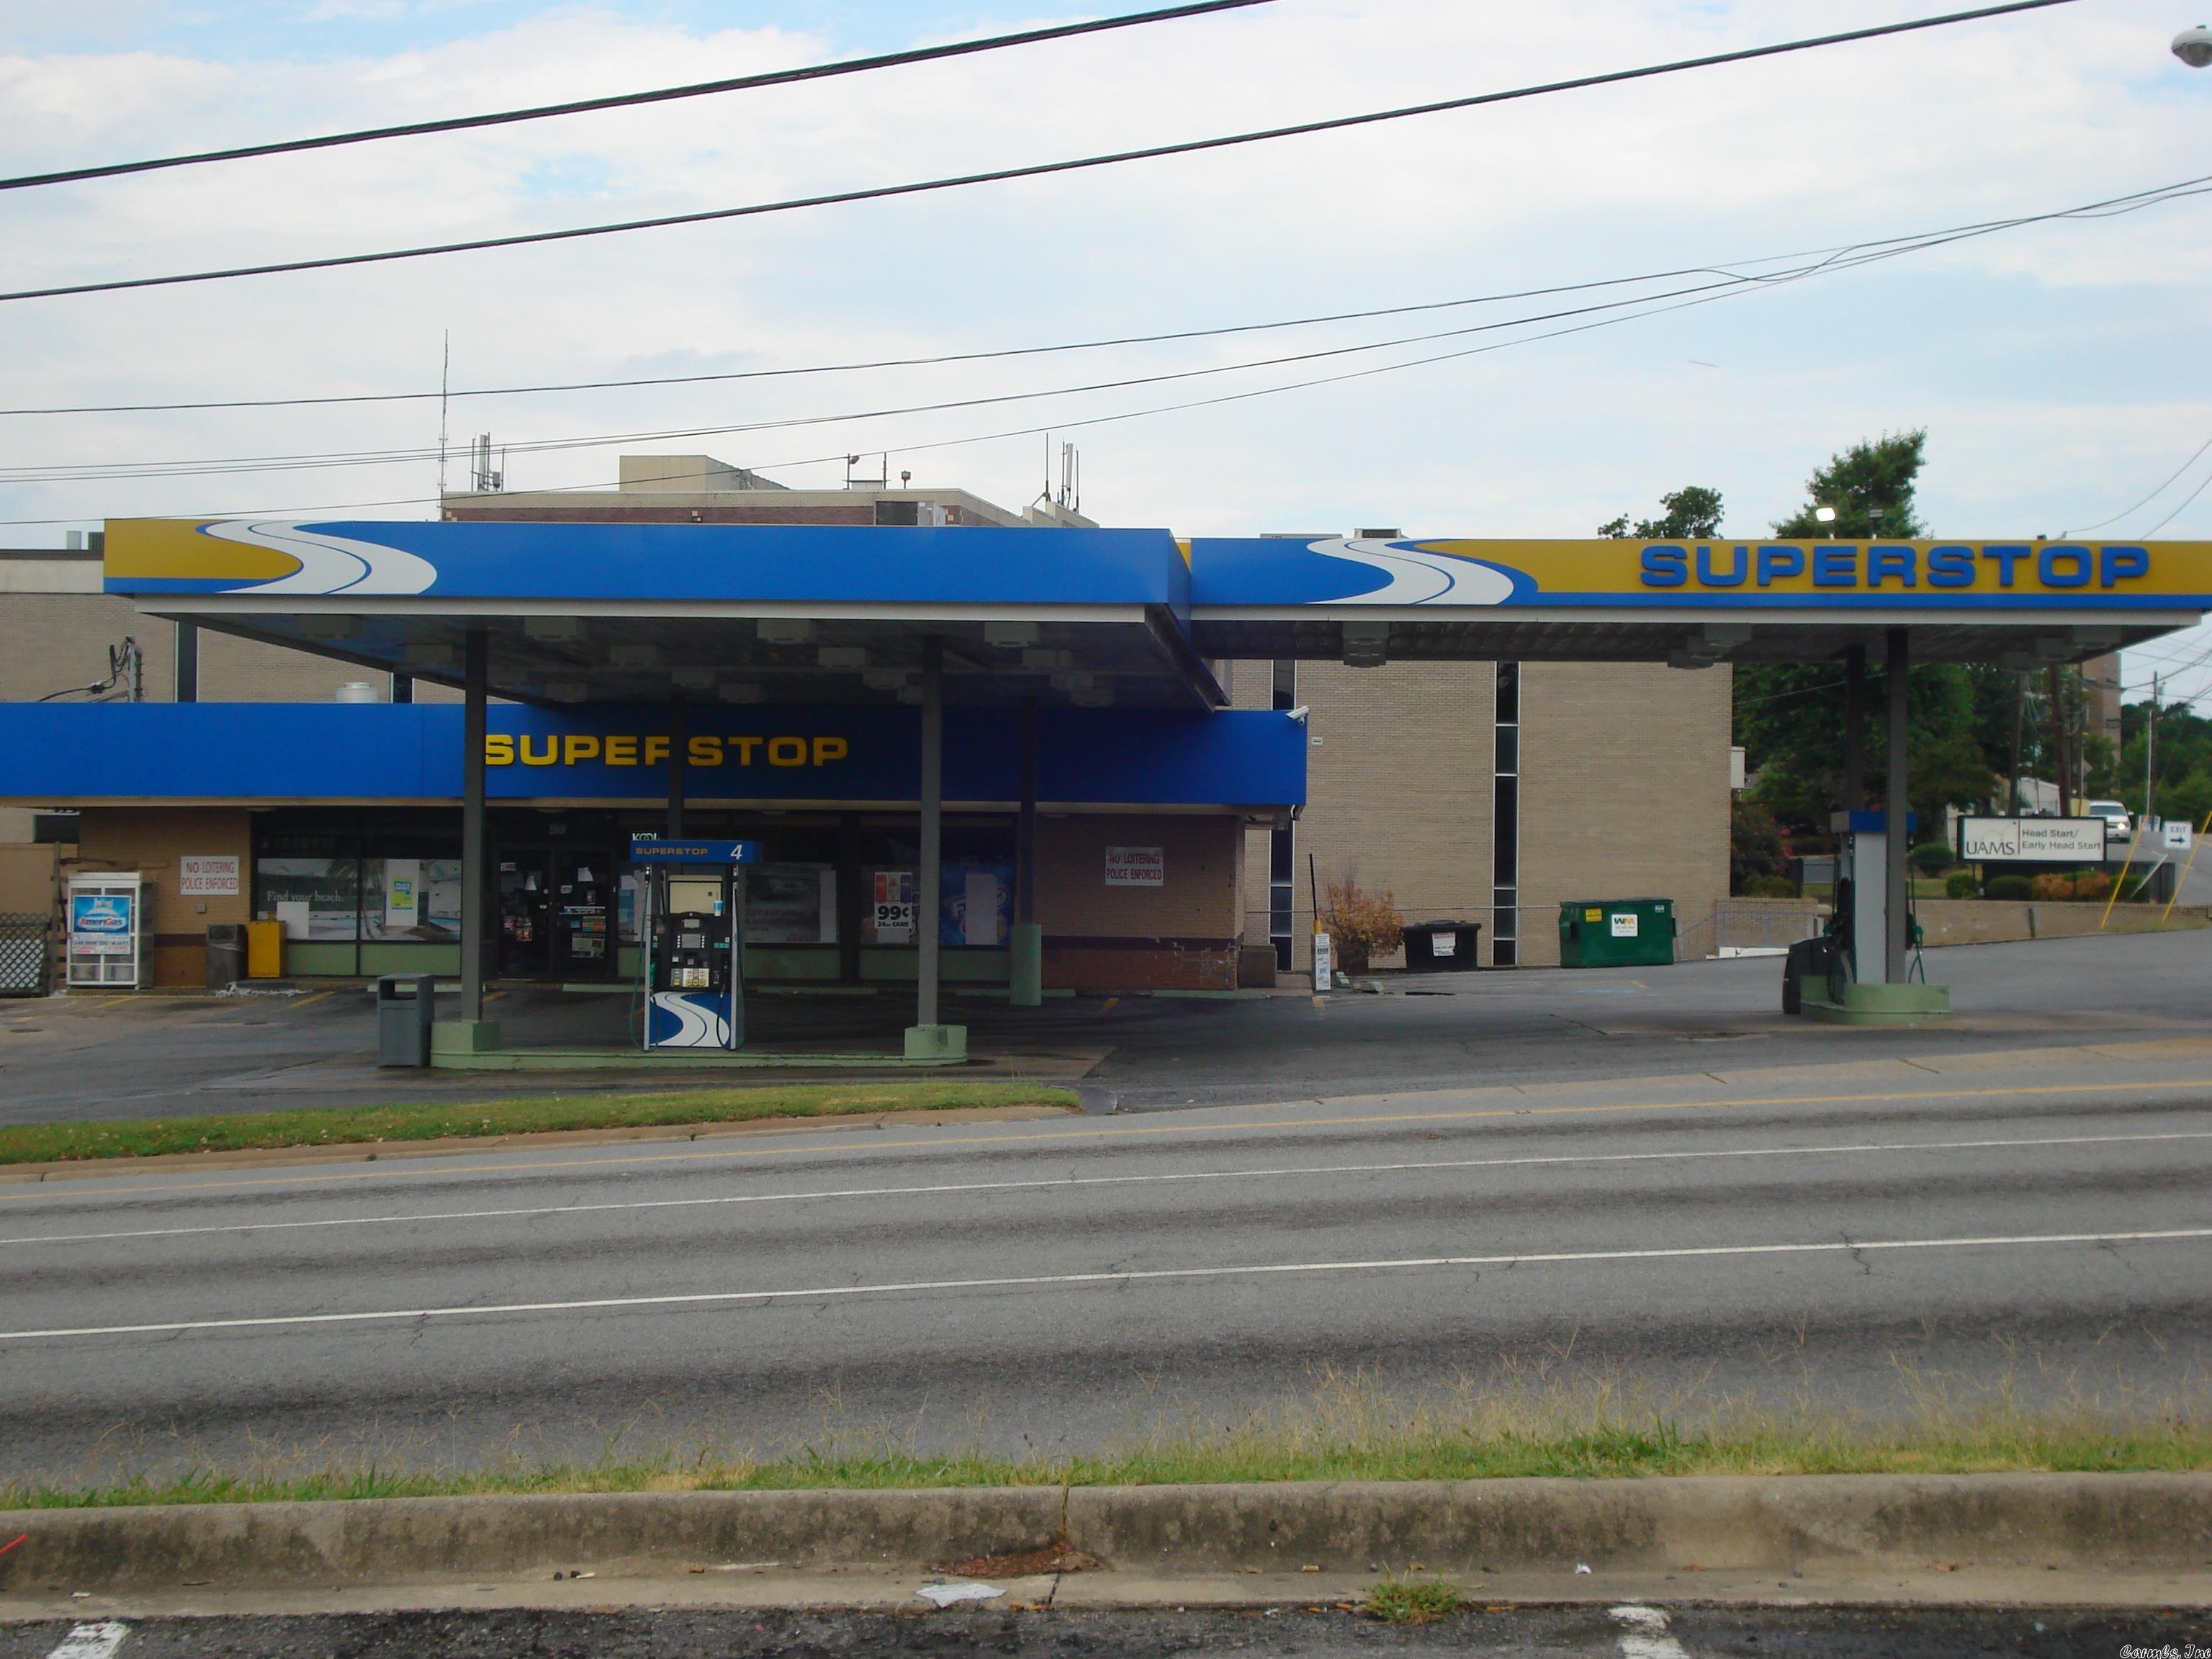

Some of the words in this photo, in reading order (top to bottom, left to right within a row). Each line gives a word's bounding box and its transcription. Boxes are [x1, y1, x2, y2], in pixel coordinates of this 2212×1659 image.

[1640, 545, 2150, 587] SUPERSTOP
[1966, 841, 2015, 855] UAMS
[2022, 841, 2046, 850] Early
[2049, 841, 2074, 850] Head
[730, 844, 743, 860] 4
[1109, 853, 1120, 864] NO
[1124, 853, 1160, 864] LOITERING
[186, 861, 199, 873] NO
[202, 861, 235, 873] LOITERING
[1107, 868, 1128, 879] POLICE
[1131, 868, 1162, 880] ENFORCED
[181, 877, 202, 889] POLICE
[206, 877, 238, 889] ENFORCED
[267, 890, 289, 902] Find
[291, 894, 313, 902] your
[78, 917, 123, 926] AmeriGas
